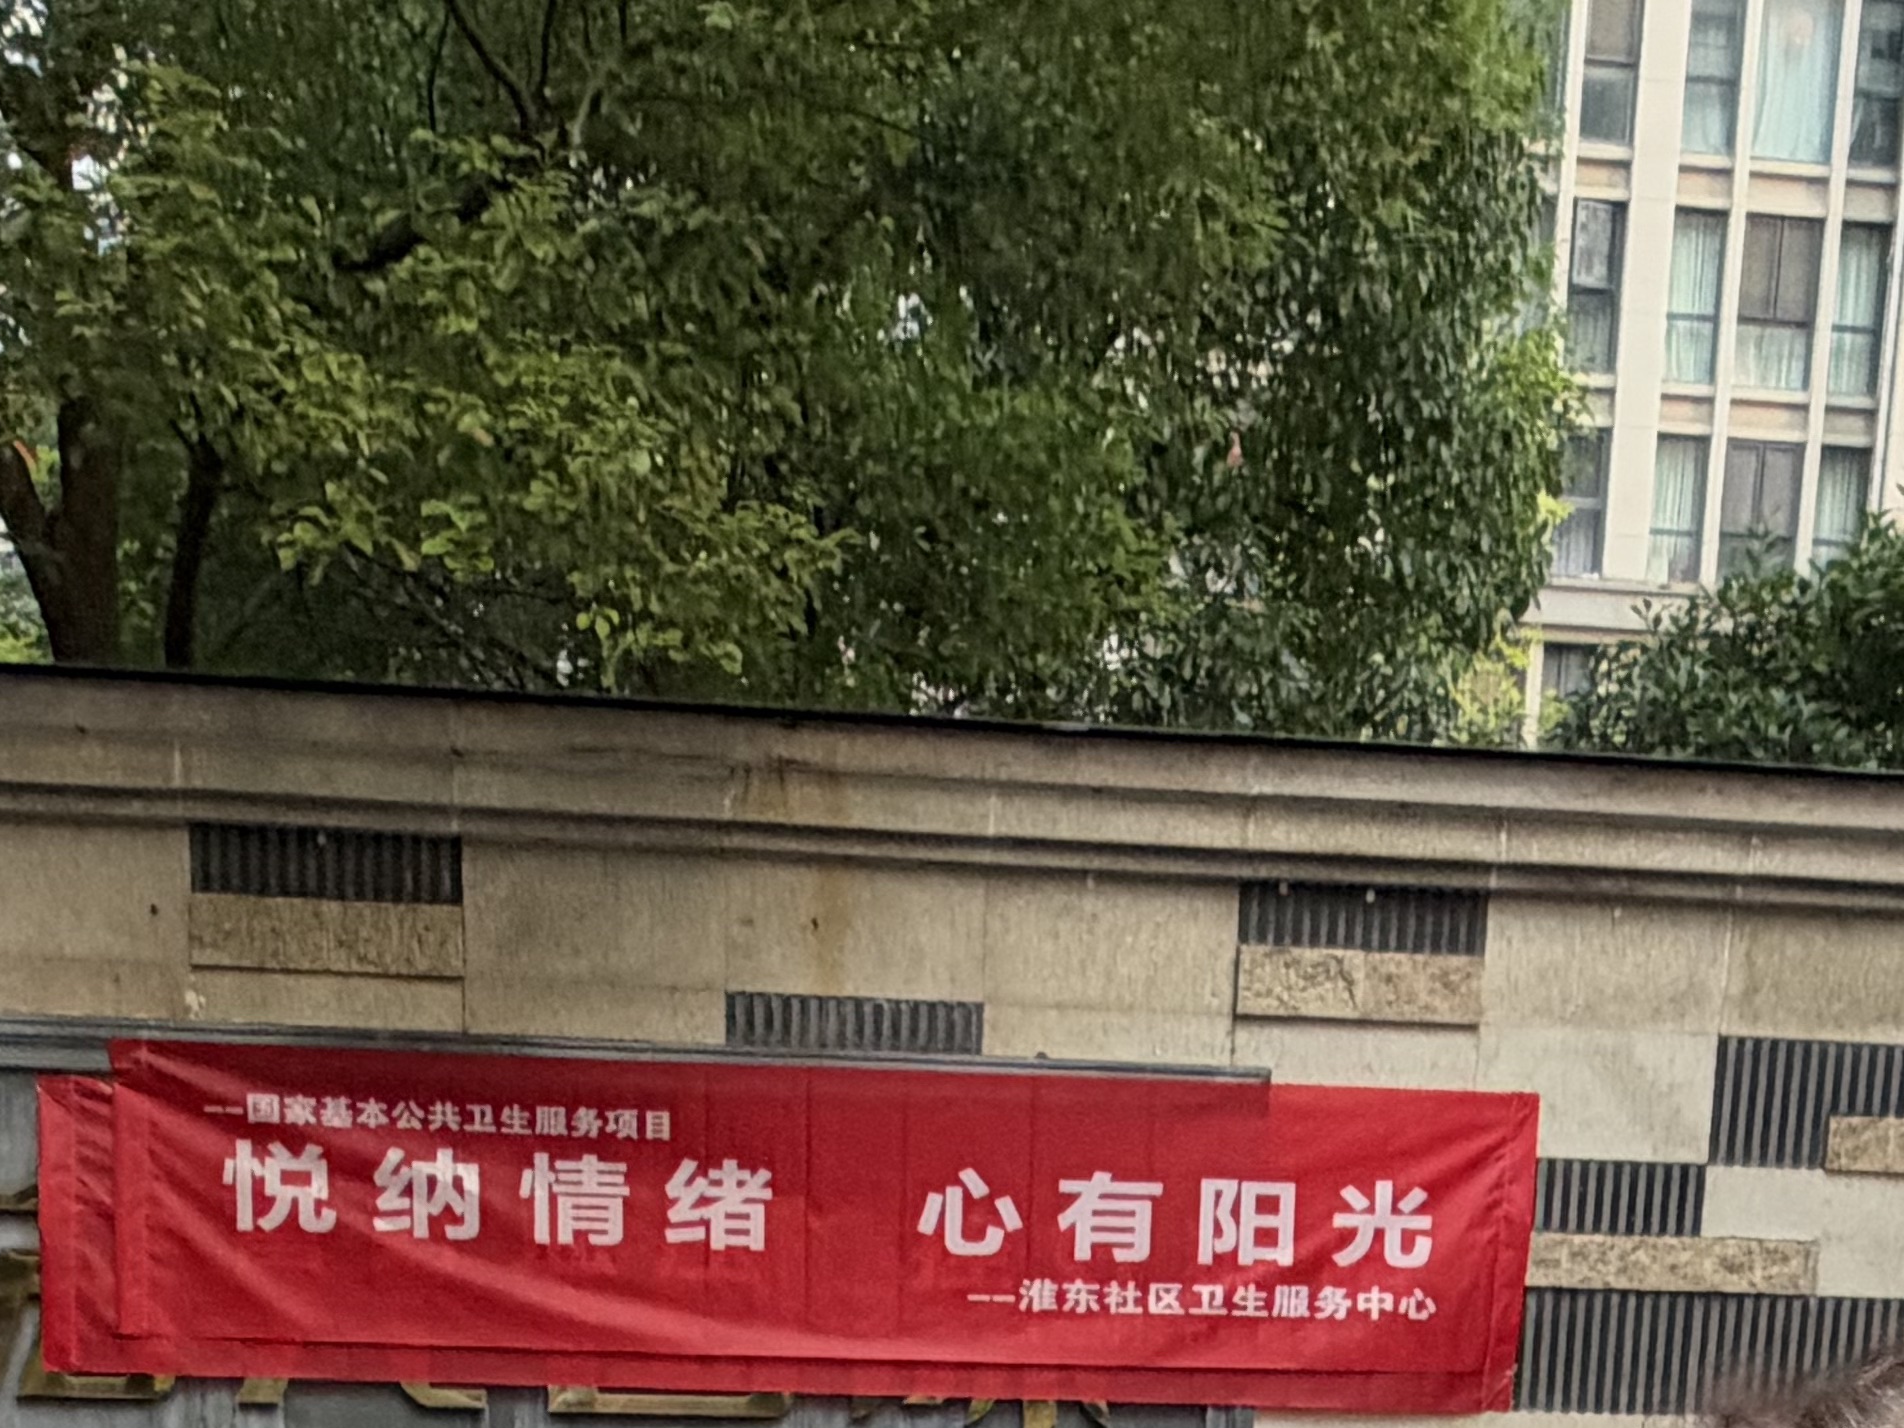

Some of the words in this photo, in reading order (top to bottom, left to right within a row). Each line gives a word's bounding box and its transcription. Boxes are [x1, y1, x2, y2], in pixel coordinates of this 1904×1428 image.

[222, 1138, 773, 1252] 悦纳情绪
[917, 1167, 1433, 1269] 心有阳光
